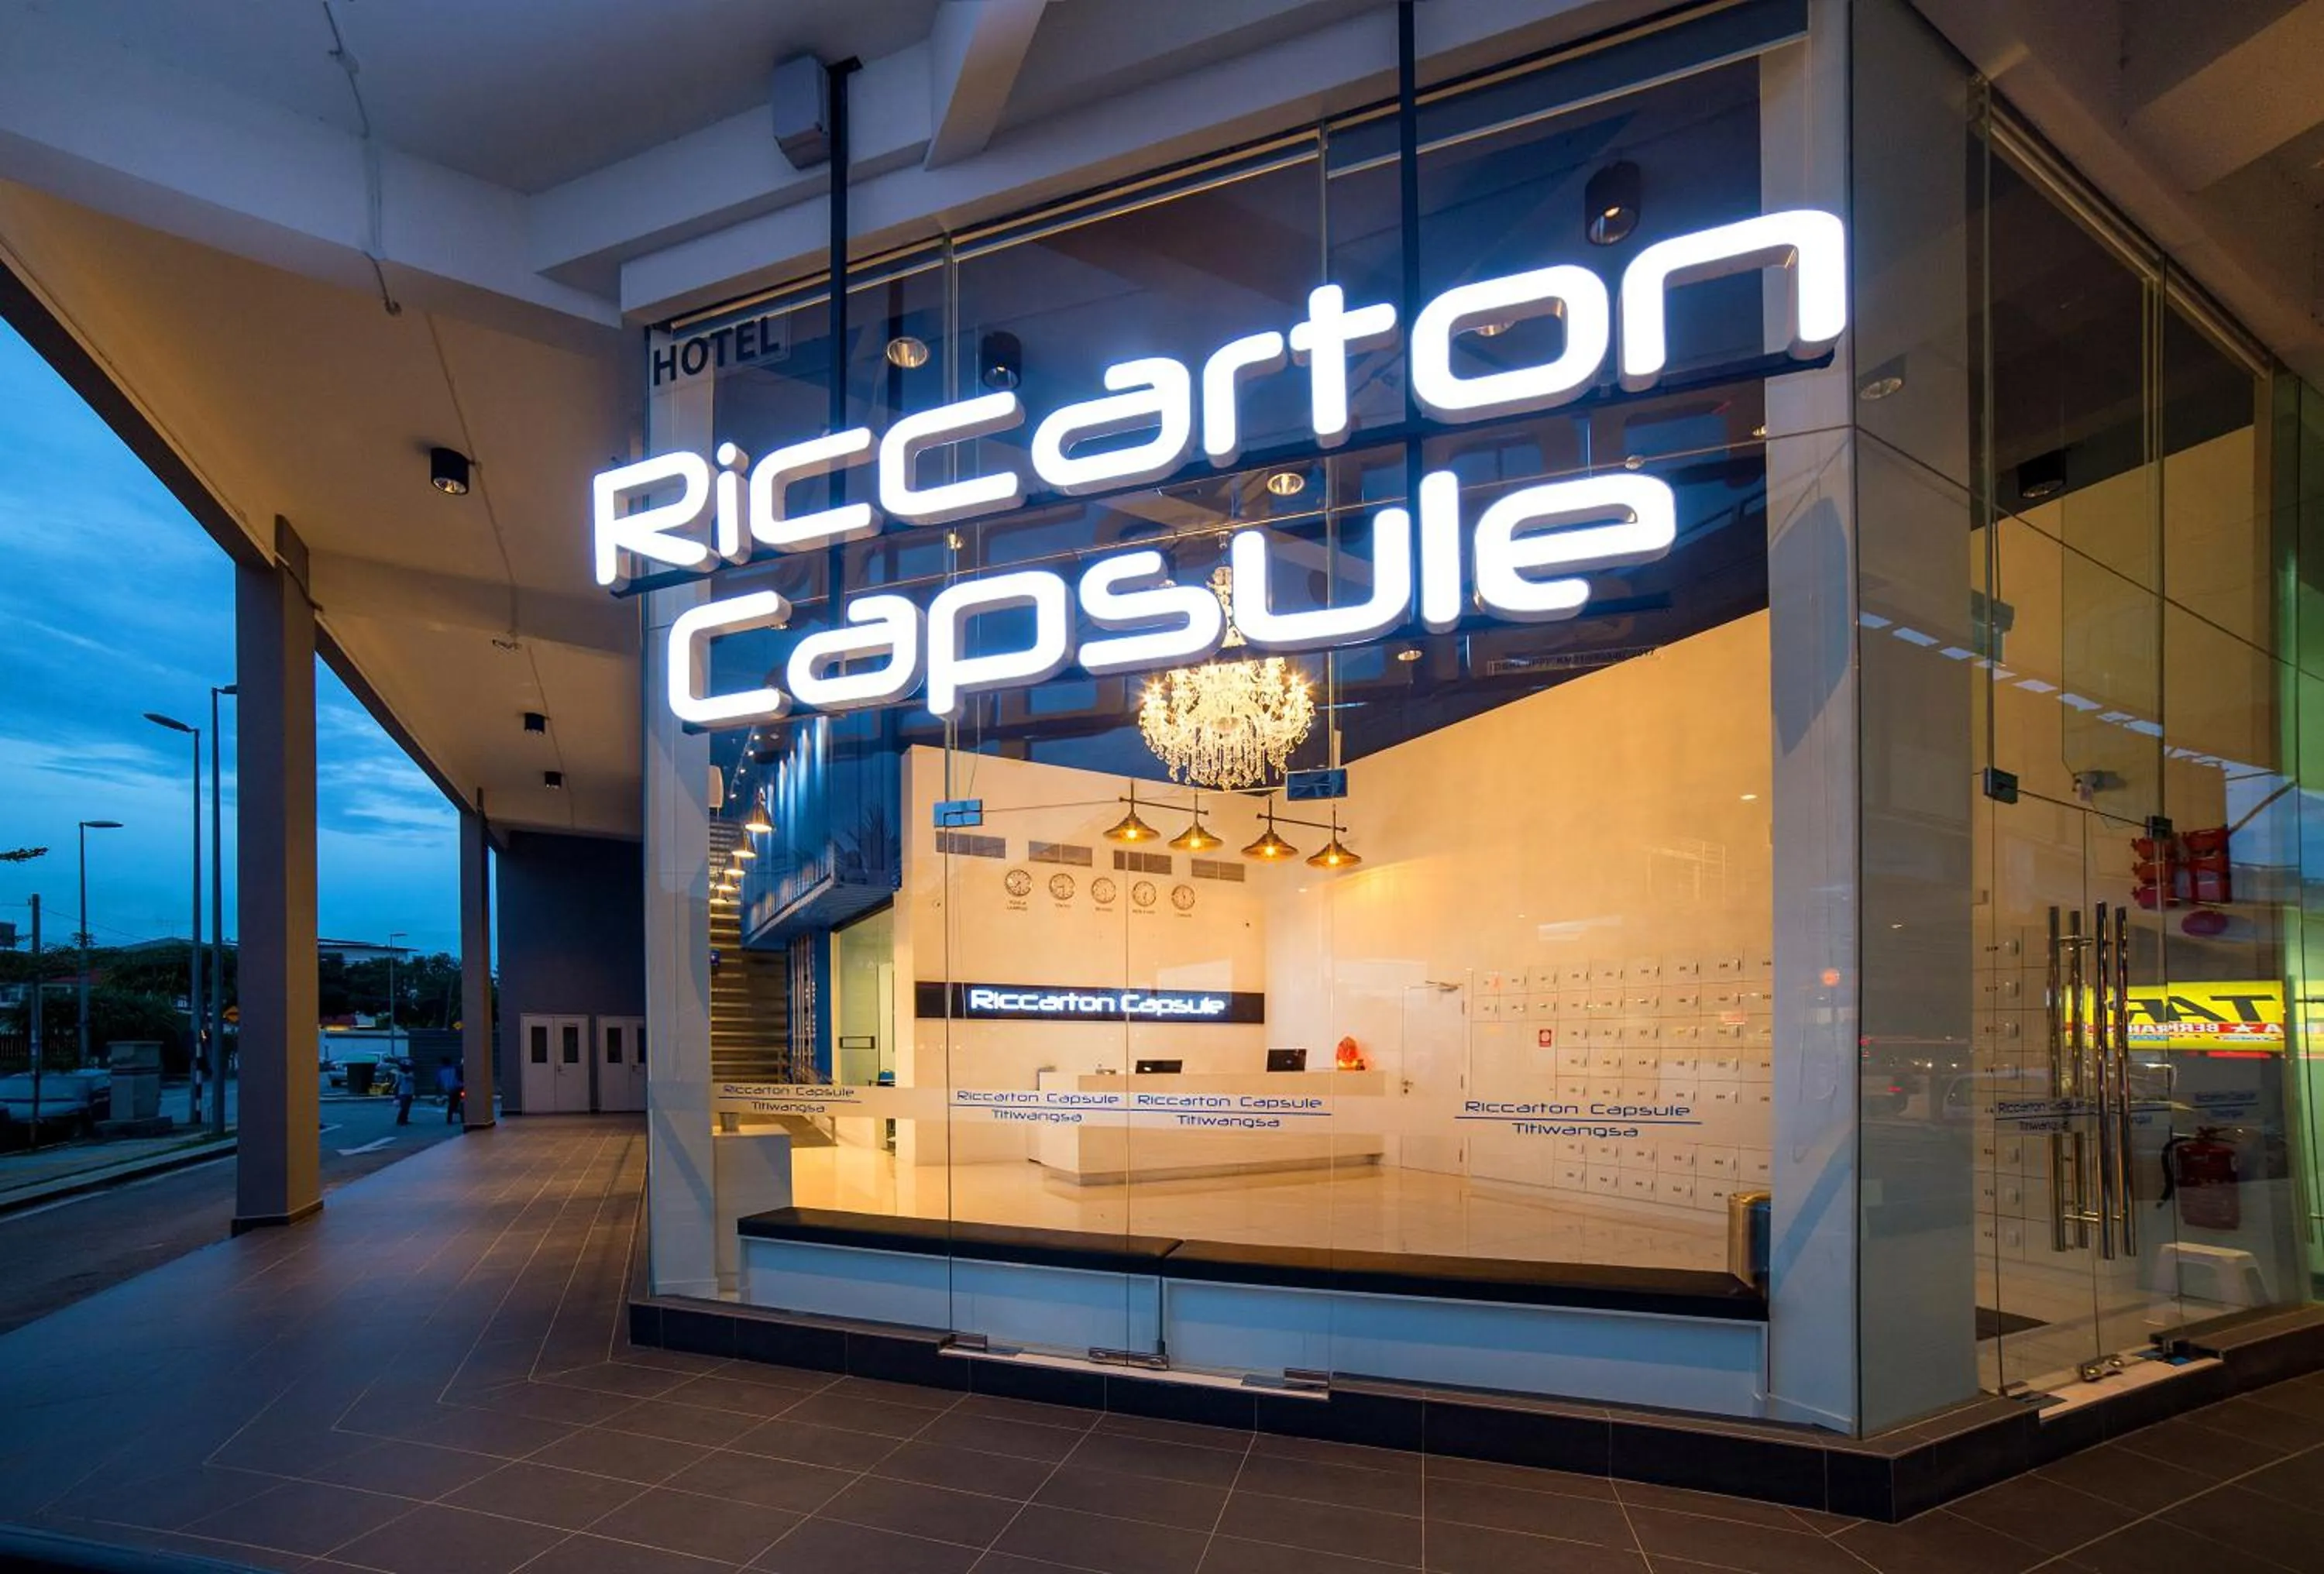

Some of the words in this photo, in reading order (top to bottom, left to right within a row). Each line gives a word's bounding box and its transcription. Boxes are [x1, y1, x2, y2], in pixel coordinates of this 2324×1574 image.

[653, 317, 780, 386] HOTEL
[591, 208, 1848, 589] Riccarton
[665, 470, 1678, 727] Capsule
[970, 988, 1115, 1012] Riccarton
[1120, 994, 1226, 1016] Capsule
[724, 1084, 790, 1096] Riccarton
[795, 1086, 855, 1098] Capsule
[956, 1090, 1039, 1103] Riccarton
[1046, 1092, 1120, 1106] Capsule
[751, 1101, 826, 1114] Titiwangsa
[1137, 1094, 1231, 1108] Riccarton
[1239, 1096, 1322, 1110] Capsule
[1464, 1101, 1579, 1114] Riccarton
[1590, 1103, 1690, 1117] Capsule
[991, 1108, 1083, 1123] Titiwangsa
[1177, 1114, 1280, 1129] Titiwangsa
[1511, 1122, 1638, 1139] Titiwangsa
